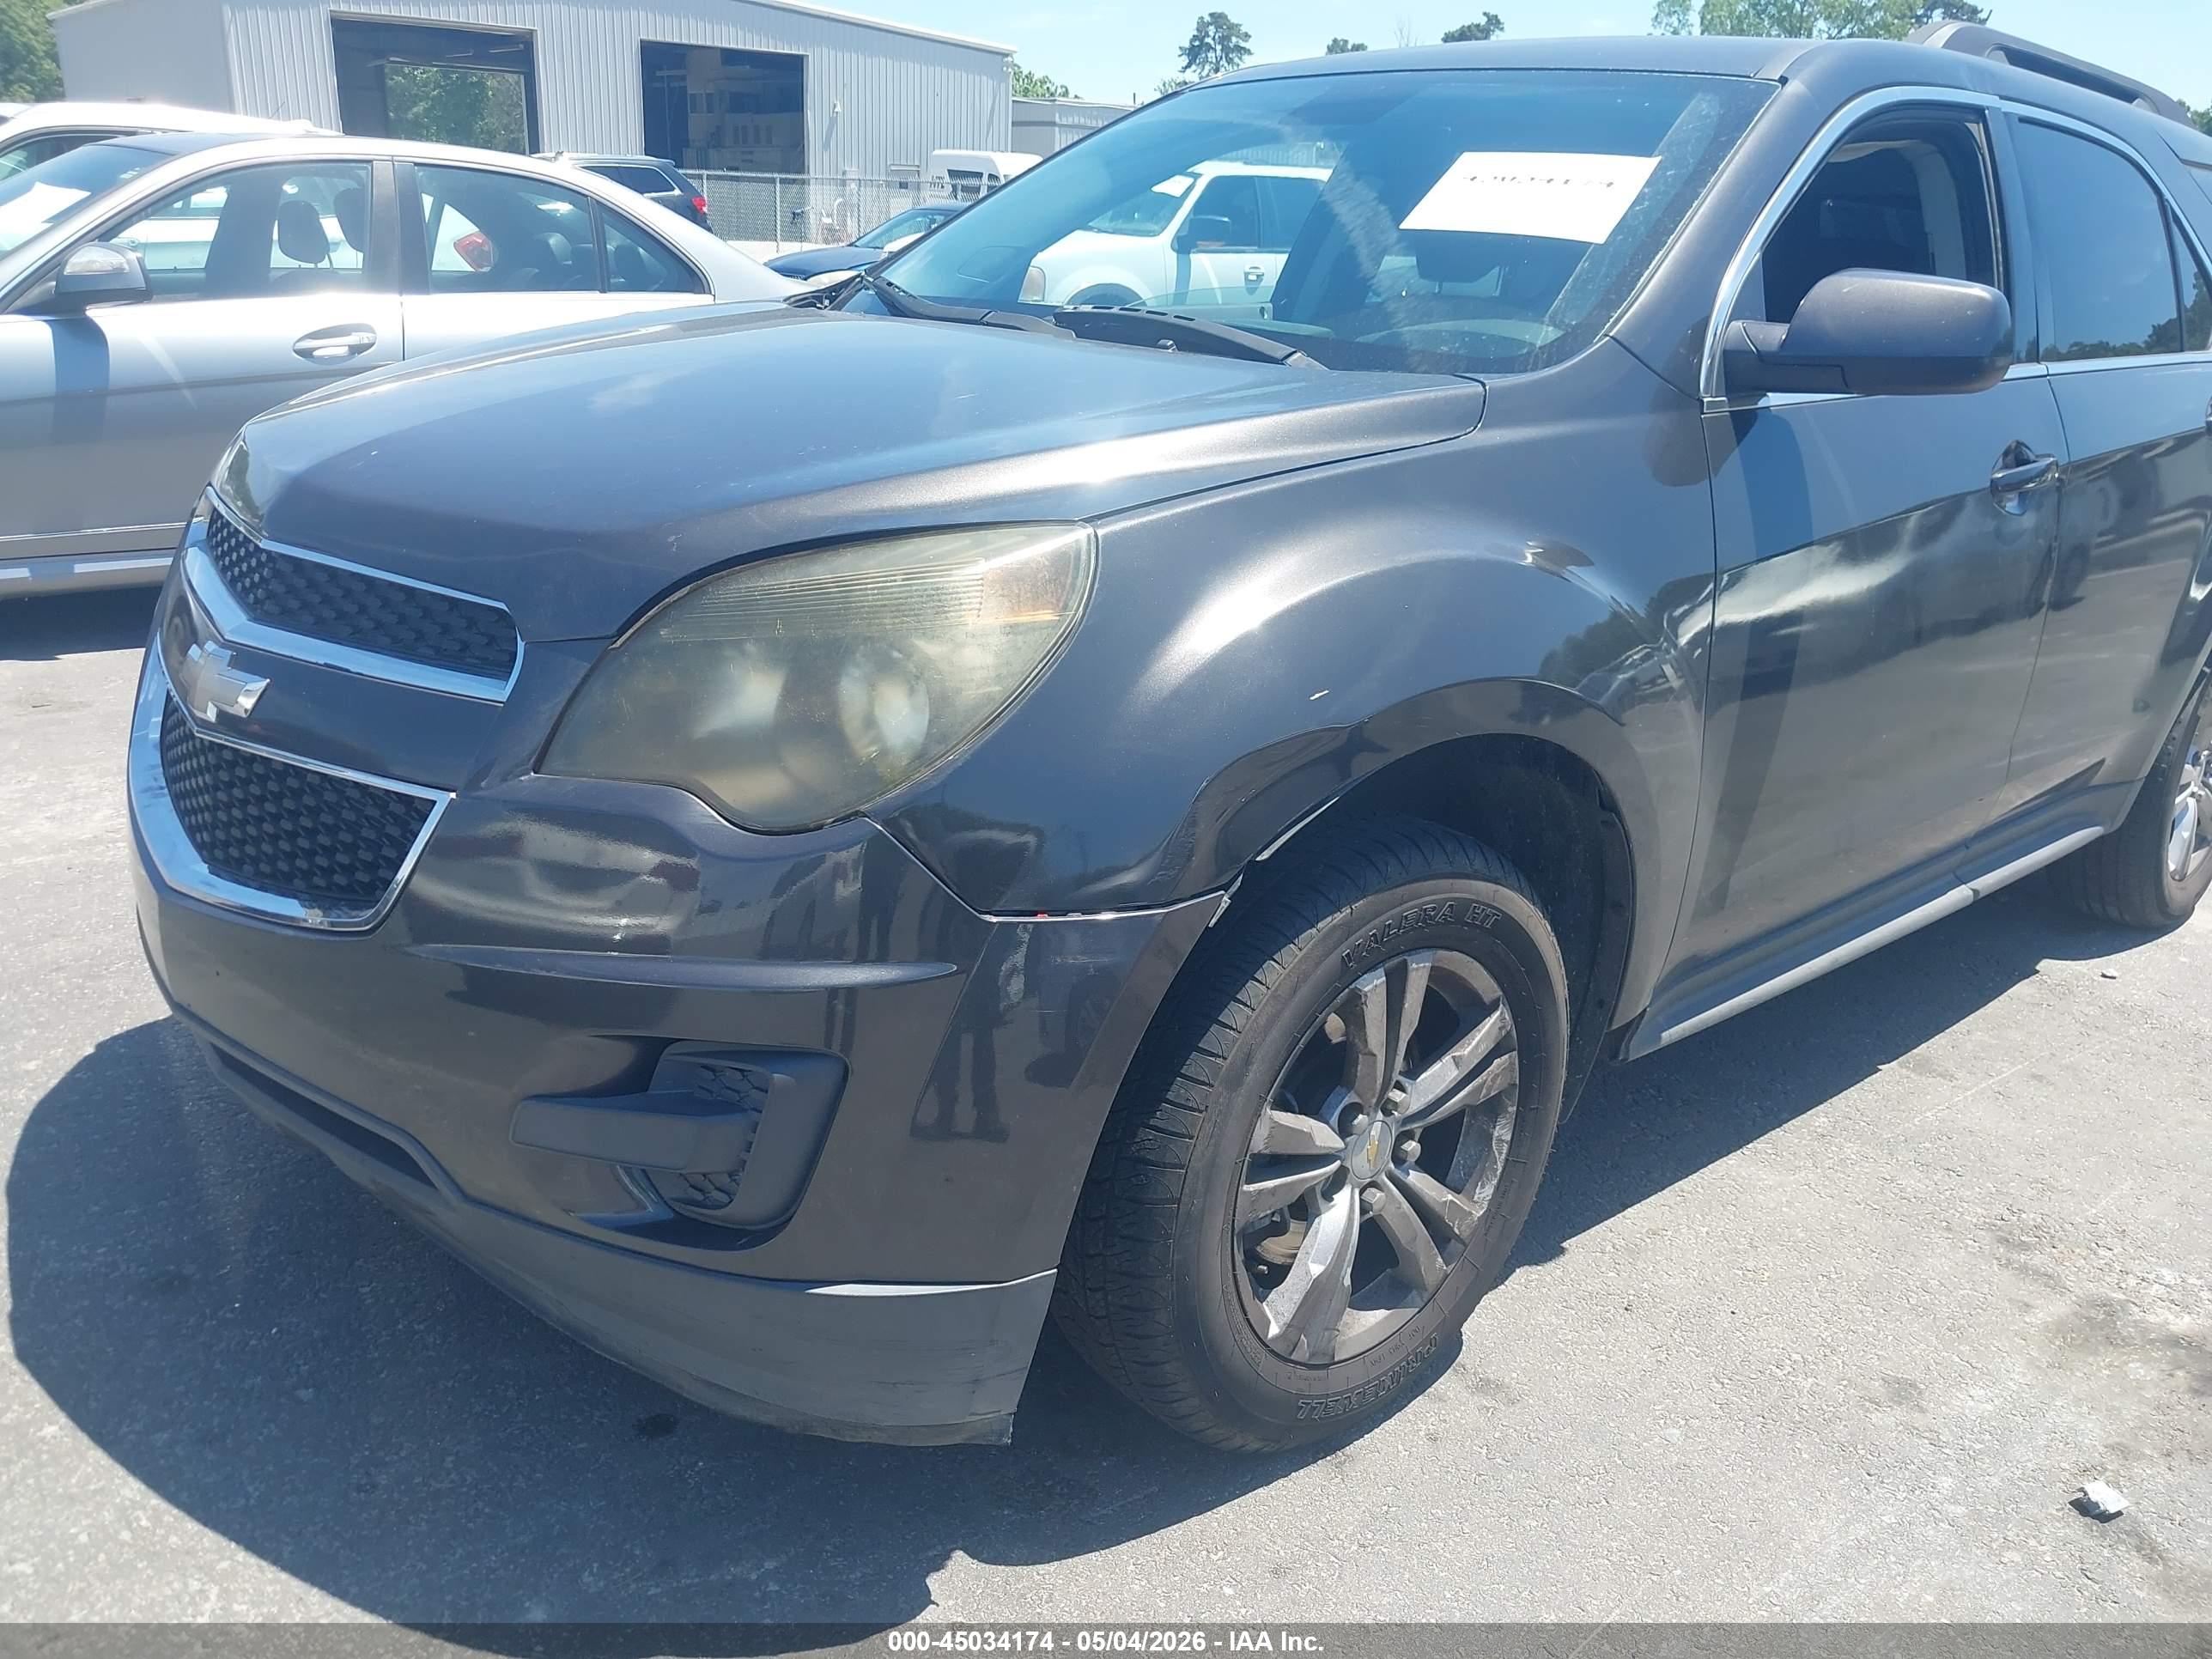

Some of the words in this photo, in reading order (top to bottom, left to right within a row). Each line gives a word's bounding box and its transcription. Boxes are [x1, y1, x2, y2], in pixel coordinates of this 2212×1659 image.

[1340, 901, 1457, 969] VALERA
[1463, 902, 1504, 930] HT
[1296, 1332, 1439, 1420] PRIMEWELL
